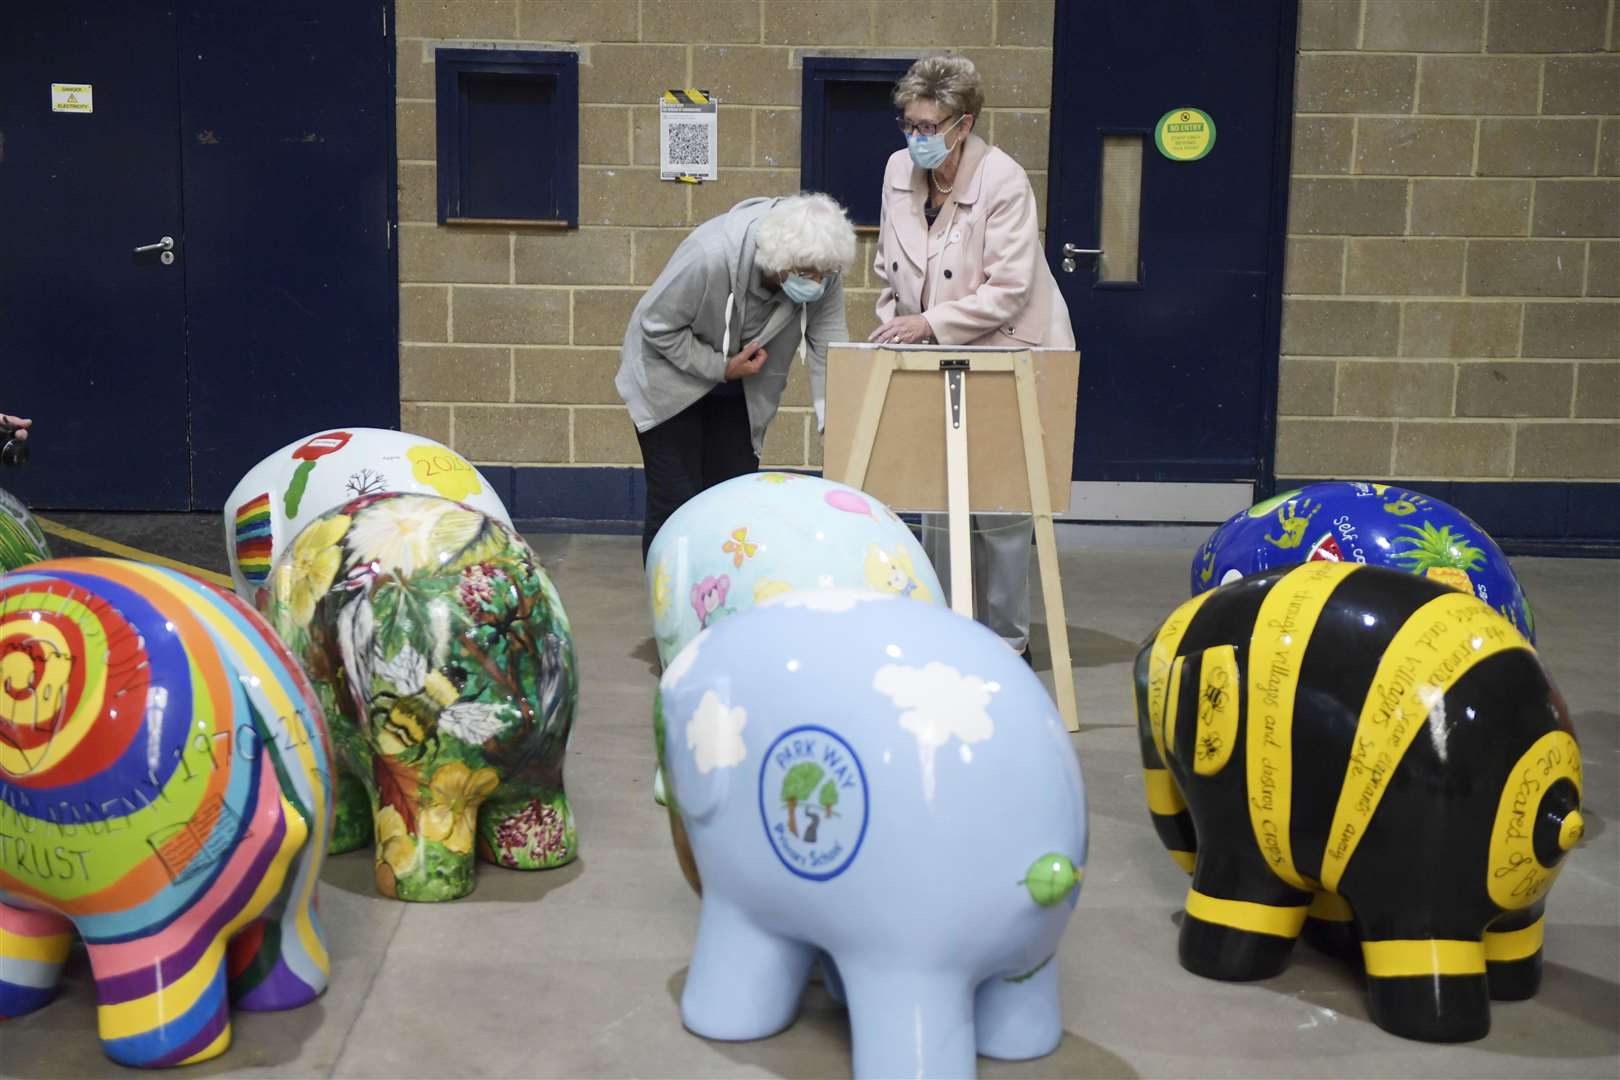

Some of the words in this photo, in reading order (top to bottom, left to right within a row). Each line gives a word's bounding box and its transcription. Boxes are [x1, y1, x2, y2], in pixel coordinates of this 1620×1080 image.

[1169, 124, 1180, 132] NO
[1180, 123, 1203, 132] ENTRY
[1256, 651, 1291, 709] villages
[1264, 715, 1281, 748] and
[776, 739, 816, 771] PARK
[823, 745, 856, 789] WAY
[0, 832, 90, 881] TRUST
[809, 838, 843, 867] School
[1328, 824, 1356, 861] away
